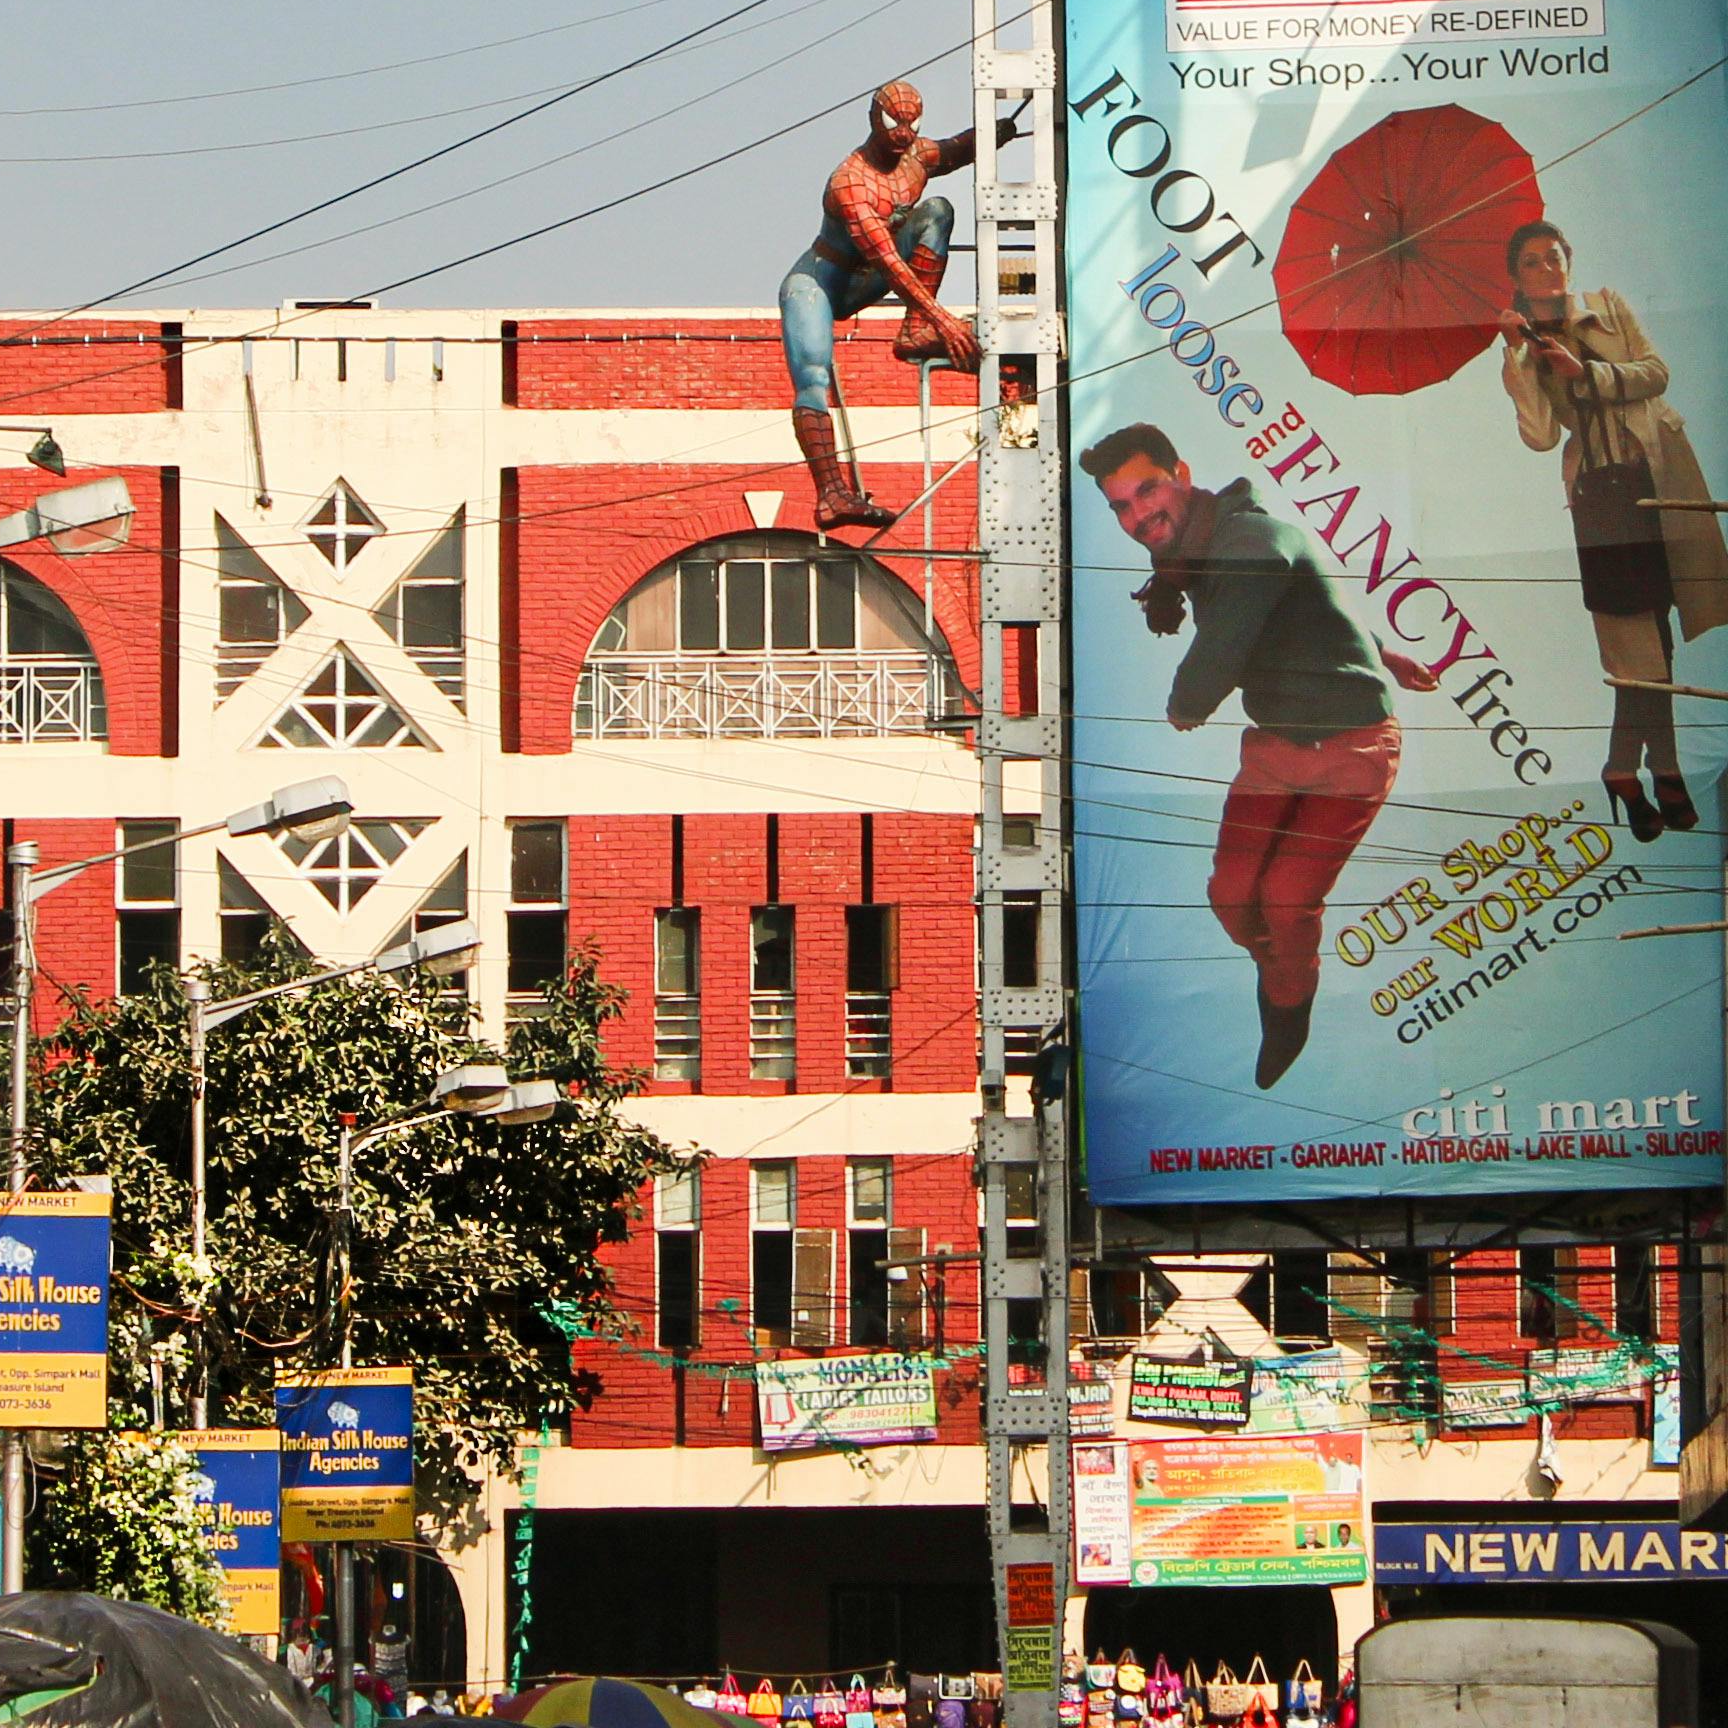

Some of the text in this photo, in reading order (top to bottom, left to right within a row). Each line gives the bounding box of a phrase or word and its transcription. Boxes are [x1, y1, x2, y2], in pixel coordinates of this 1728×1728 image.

[1175, 5, 1589, 43] VALUE FOR MONEY RE-DEFINED
[1169, 45, 1610, 92] Your World
[1065, 63, 1266, 283] FOOT
[1117, 242, 1265, 429] loose
[1243, 400, 1306, 462] and
[1333, 875, 1449, 970] OUR
[1368, 817, 1615, 1019] our WORLD
[1395, 862, 1644, 1046] citimart.com
[1401, 1084, 1702, 1141] citi mart
[1148, 1132, 1632, 1173] NEW MARKET GARIAHAT HATIBAGAN LAKE MALL
[38, 1275, 102, 1305] House
[863, 1385, 929, 1406] TAILORS
[281, 1429, 409, 1453] Indian Silk House
[309, 1452, 381, 1475] Agencies
[218, 1502, 274, 1528] House
[1424, 1532, 1560, 1574] NEW
